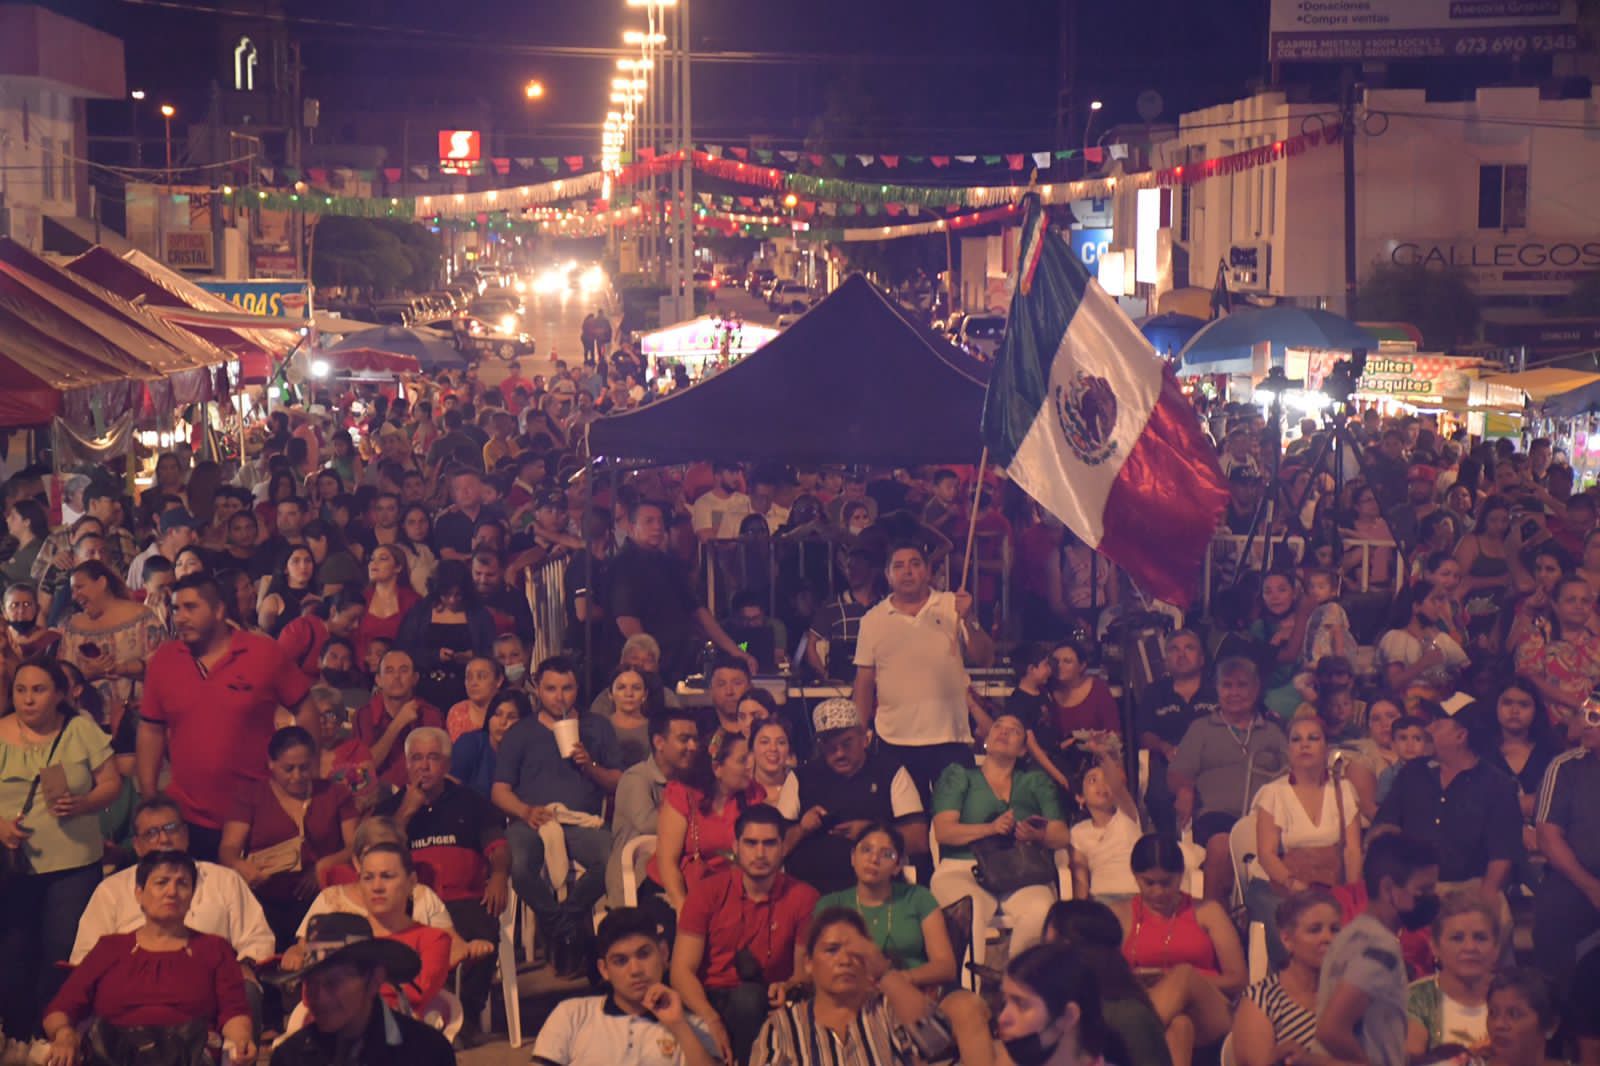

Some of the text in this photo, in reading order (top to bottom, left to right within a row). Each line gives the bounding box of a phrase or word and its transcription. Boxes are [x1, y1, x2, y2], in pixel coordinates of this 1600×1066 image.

[1304, 14, 1390, 26] Compra ventas
[1455, 33, 1577, 54] 673 690 9345
[168, 249, 209, 264] CRISTAL
[1392, 243, 1600, 266] GALLEGOS
[411, 835, 456, 848] HILFIGER
